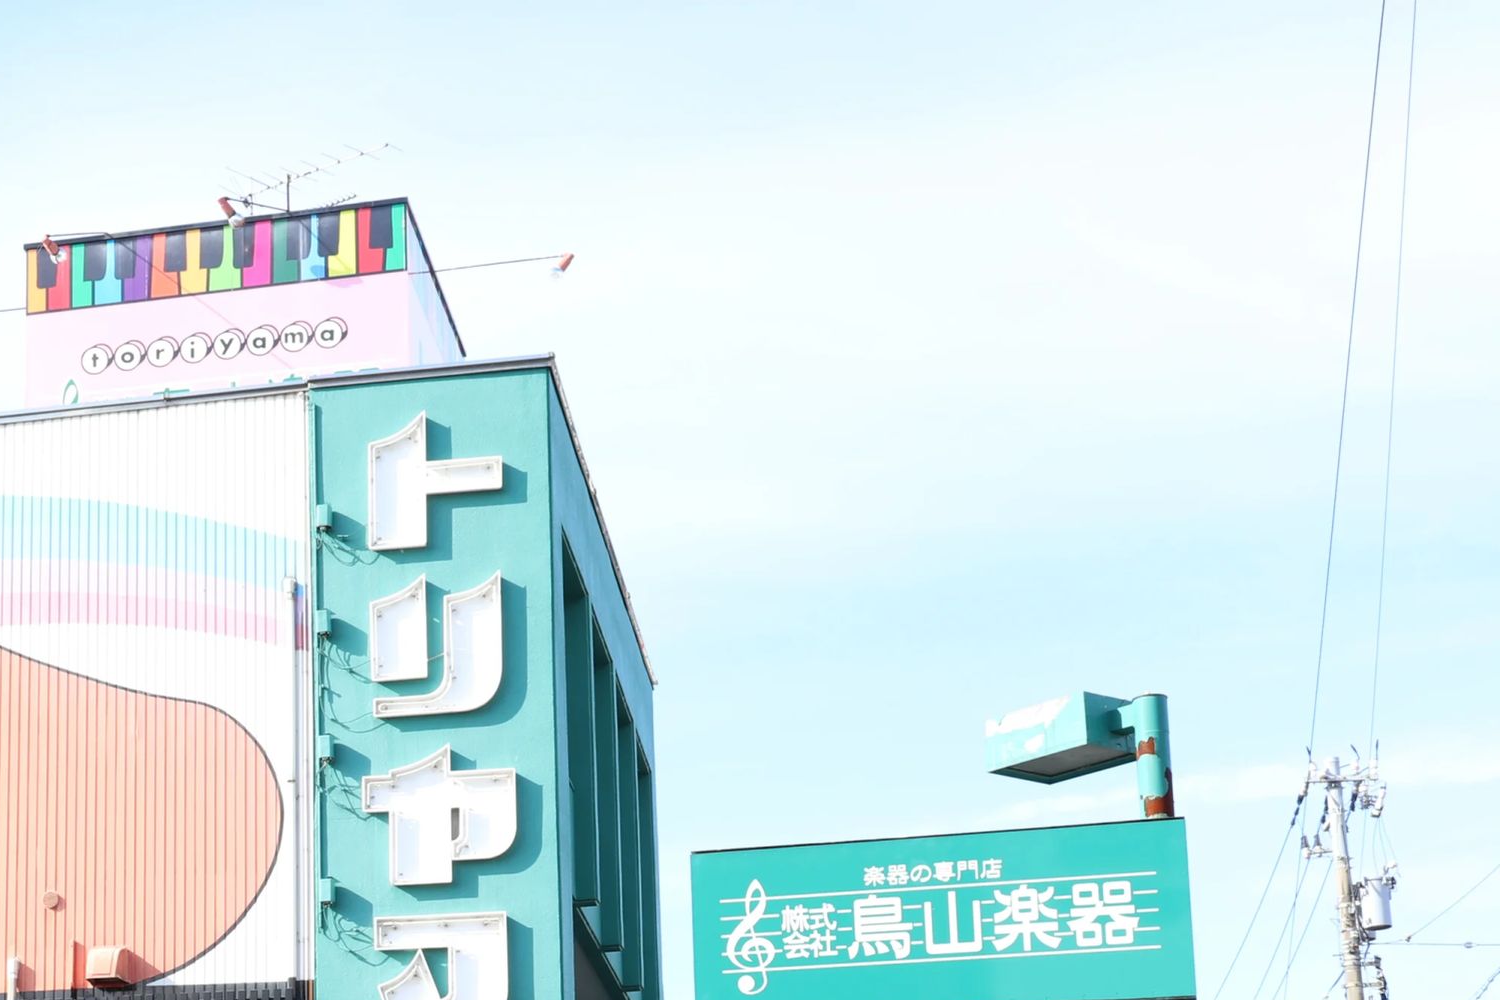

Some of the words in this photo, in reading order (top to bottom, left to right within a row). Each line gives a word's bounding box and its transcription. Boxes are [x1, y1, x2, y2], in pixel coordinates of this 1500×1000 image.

[81, 317, 347, 375] toriyama
[863, 858, 1002, 886] 楽器の専門店
[781, 903, 837, 932] 株式
[847, 880, 1139, 960] 鳥山楽器
[782, 929, 838, 958] 会社
